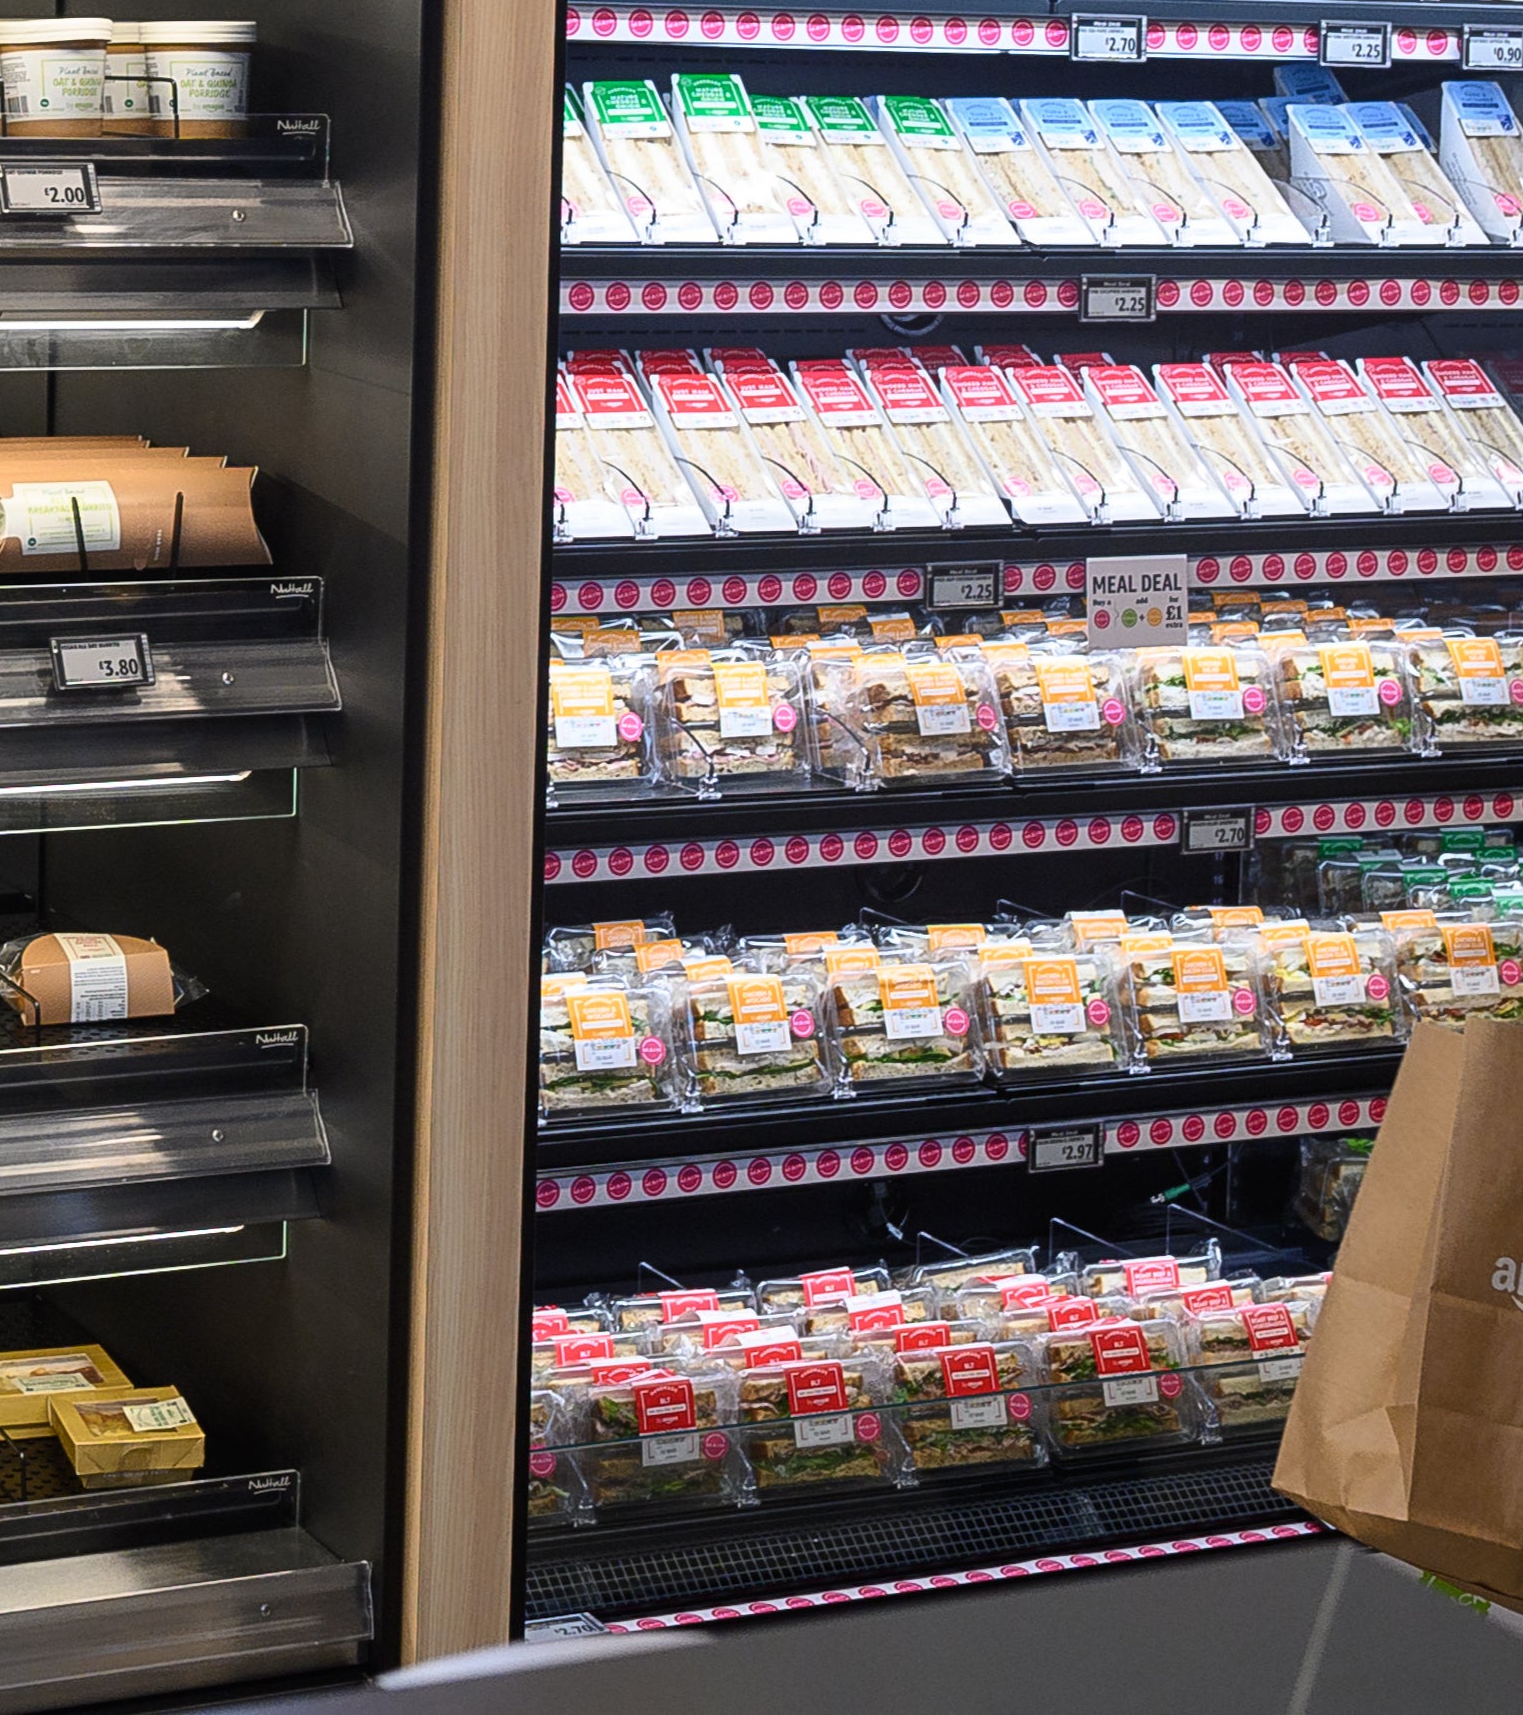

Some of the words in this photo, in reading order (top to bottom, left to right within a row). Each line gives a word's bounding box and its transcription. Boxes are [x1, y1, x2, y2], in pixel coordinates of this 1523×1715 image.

[1106, 37, 1136, 52] £2.70
[1352, 43, 1381, 58] £2.25
[1493, 46, 1522, 62] £0.90
[44, 186, 85, 203] £2.00
[1115, 296, 1145, 312] £2.25
[1092, 575, 1137, 594] MEAL
[1141, 573, 1182, 592] DEAL
[961, 584, 992, 600] £2.25
[1165, 605, 1182, 620] £1
[99, 658, 139, 676] £3.80
[1215, 826, 1245, 843] £2.70
[1062, 1143, 1092, 1161] £2.97
[1113, 1340, 1125, 1348] BLT
[963, 1362, 975, 1370] BLT
[810, 1378, 823, 1387] BLT
[659, 1396, 671, 1404] BLT
